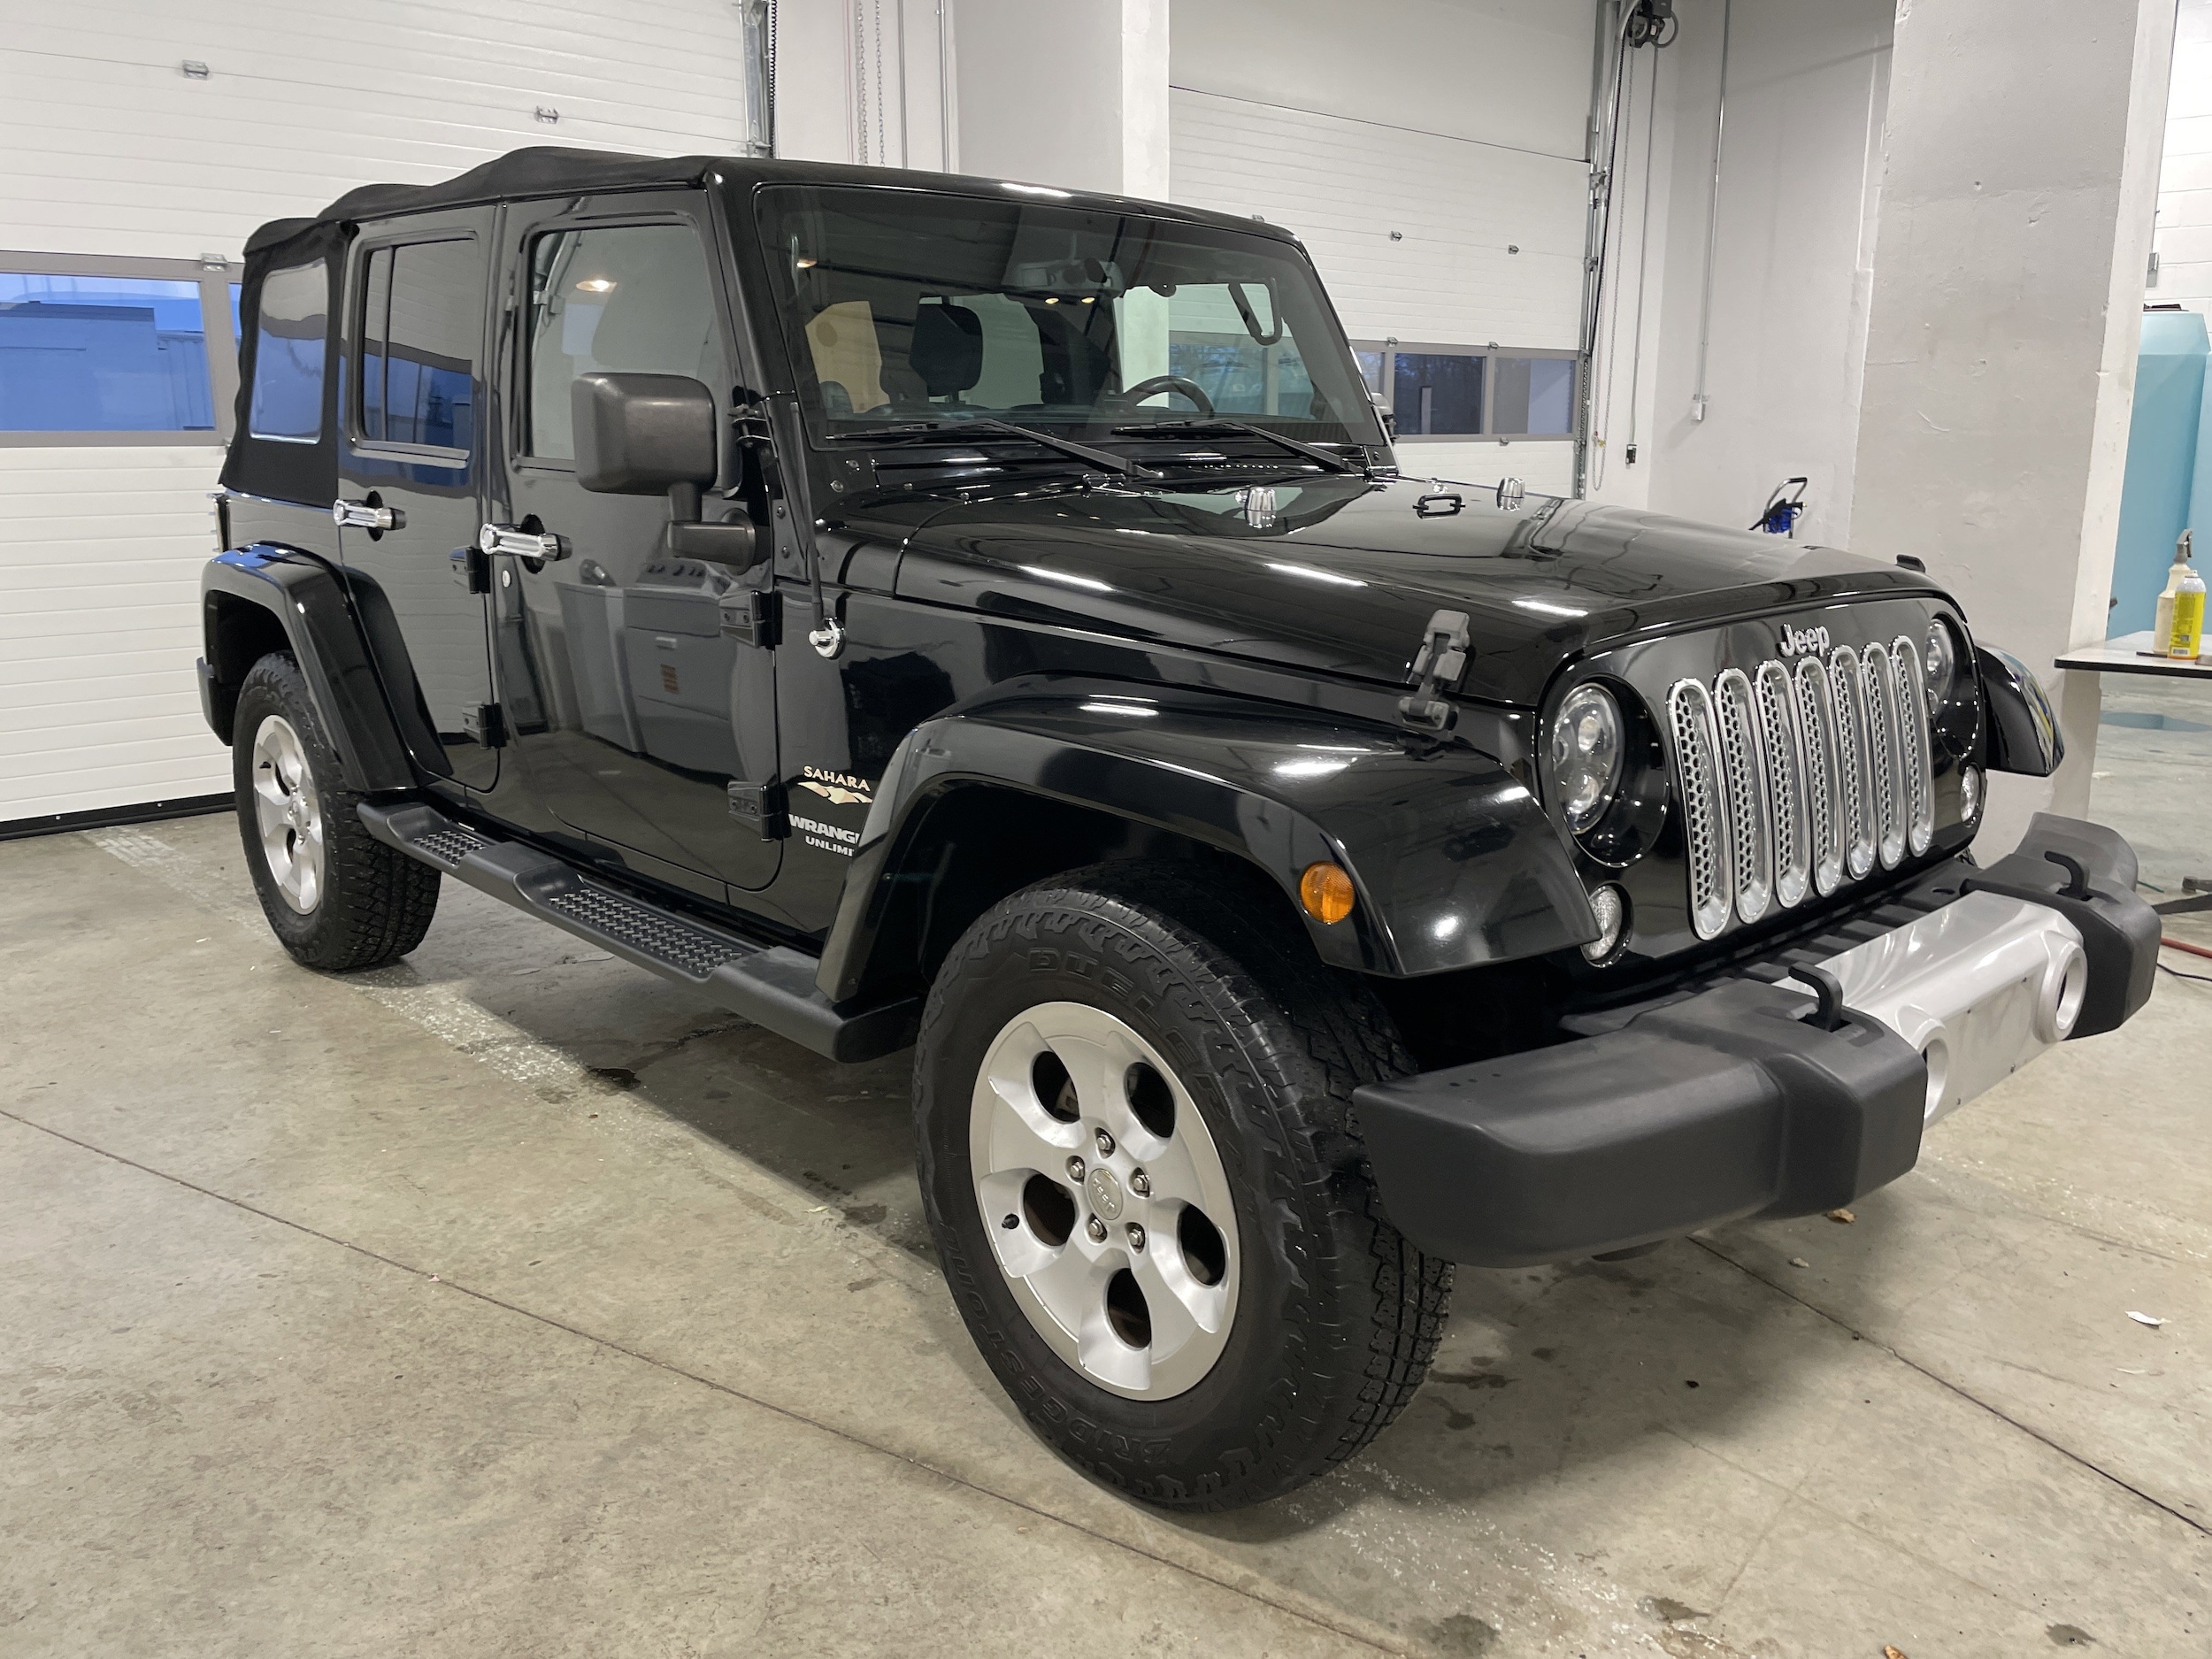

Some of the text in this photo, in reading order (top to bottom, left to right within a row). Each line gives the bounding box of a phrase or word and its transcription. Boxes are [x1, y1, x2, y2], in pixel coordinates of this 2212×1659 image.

[1779, 624, 1830, 657] Jeep
[803, 765, 871, 792] SAHARA
[805, 835, 855, 856] UNLIMI
[1028, 945, 1231, 1120] DUELER
[939, 1221, 1172, 1464] BRIDGESTONE
